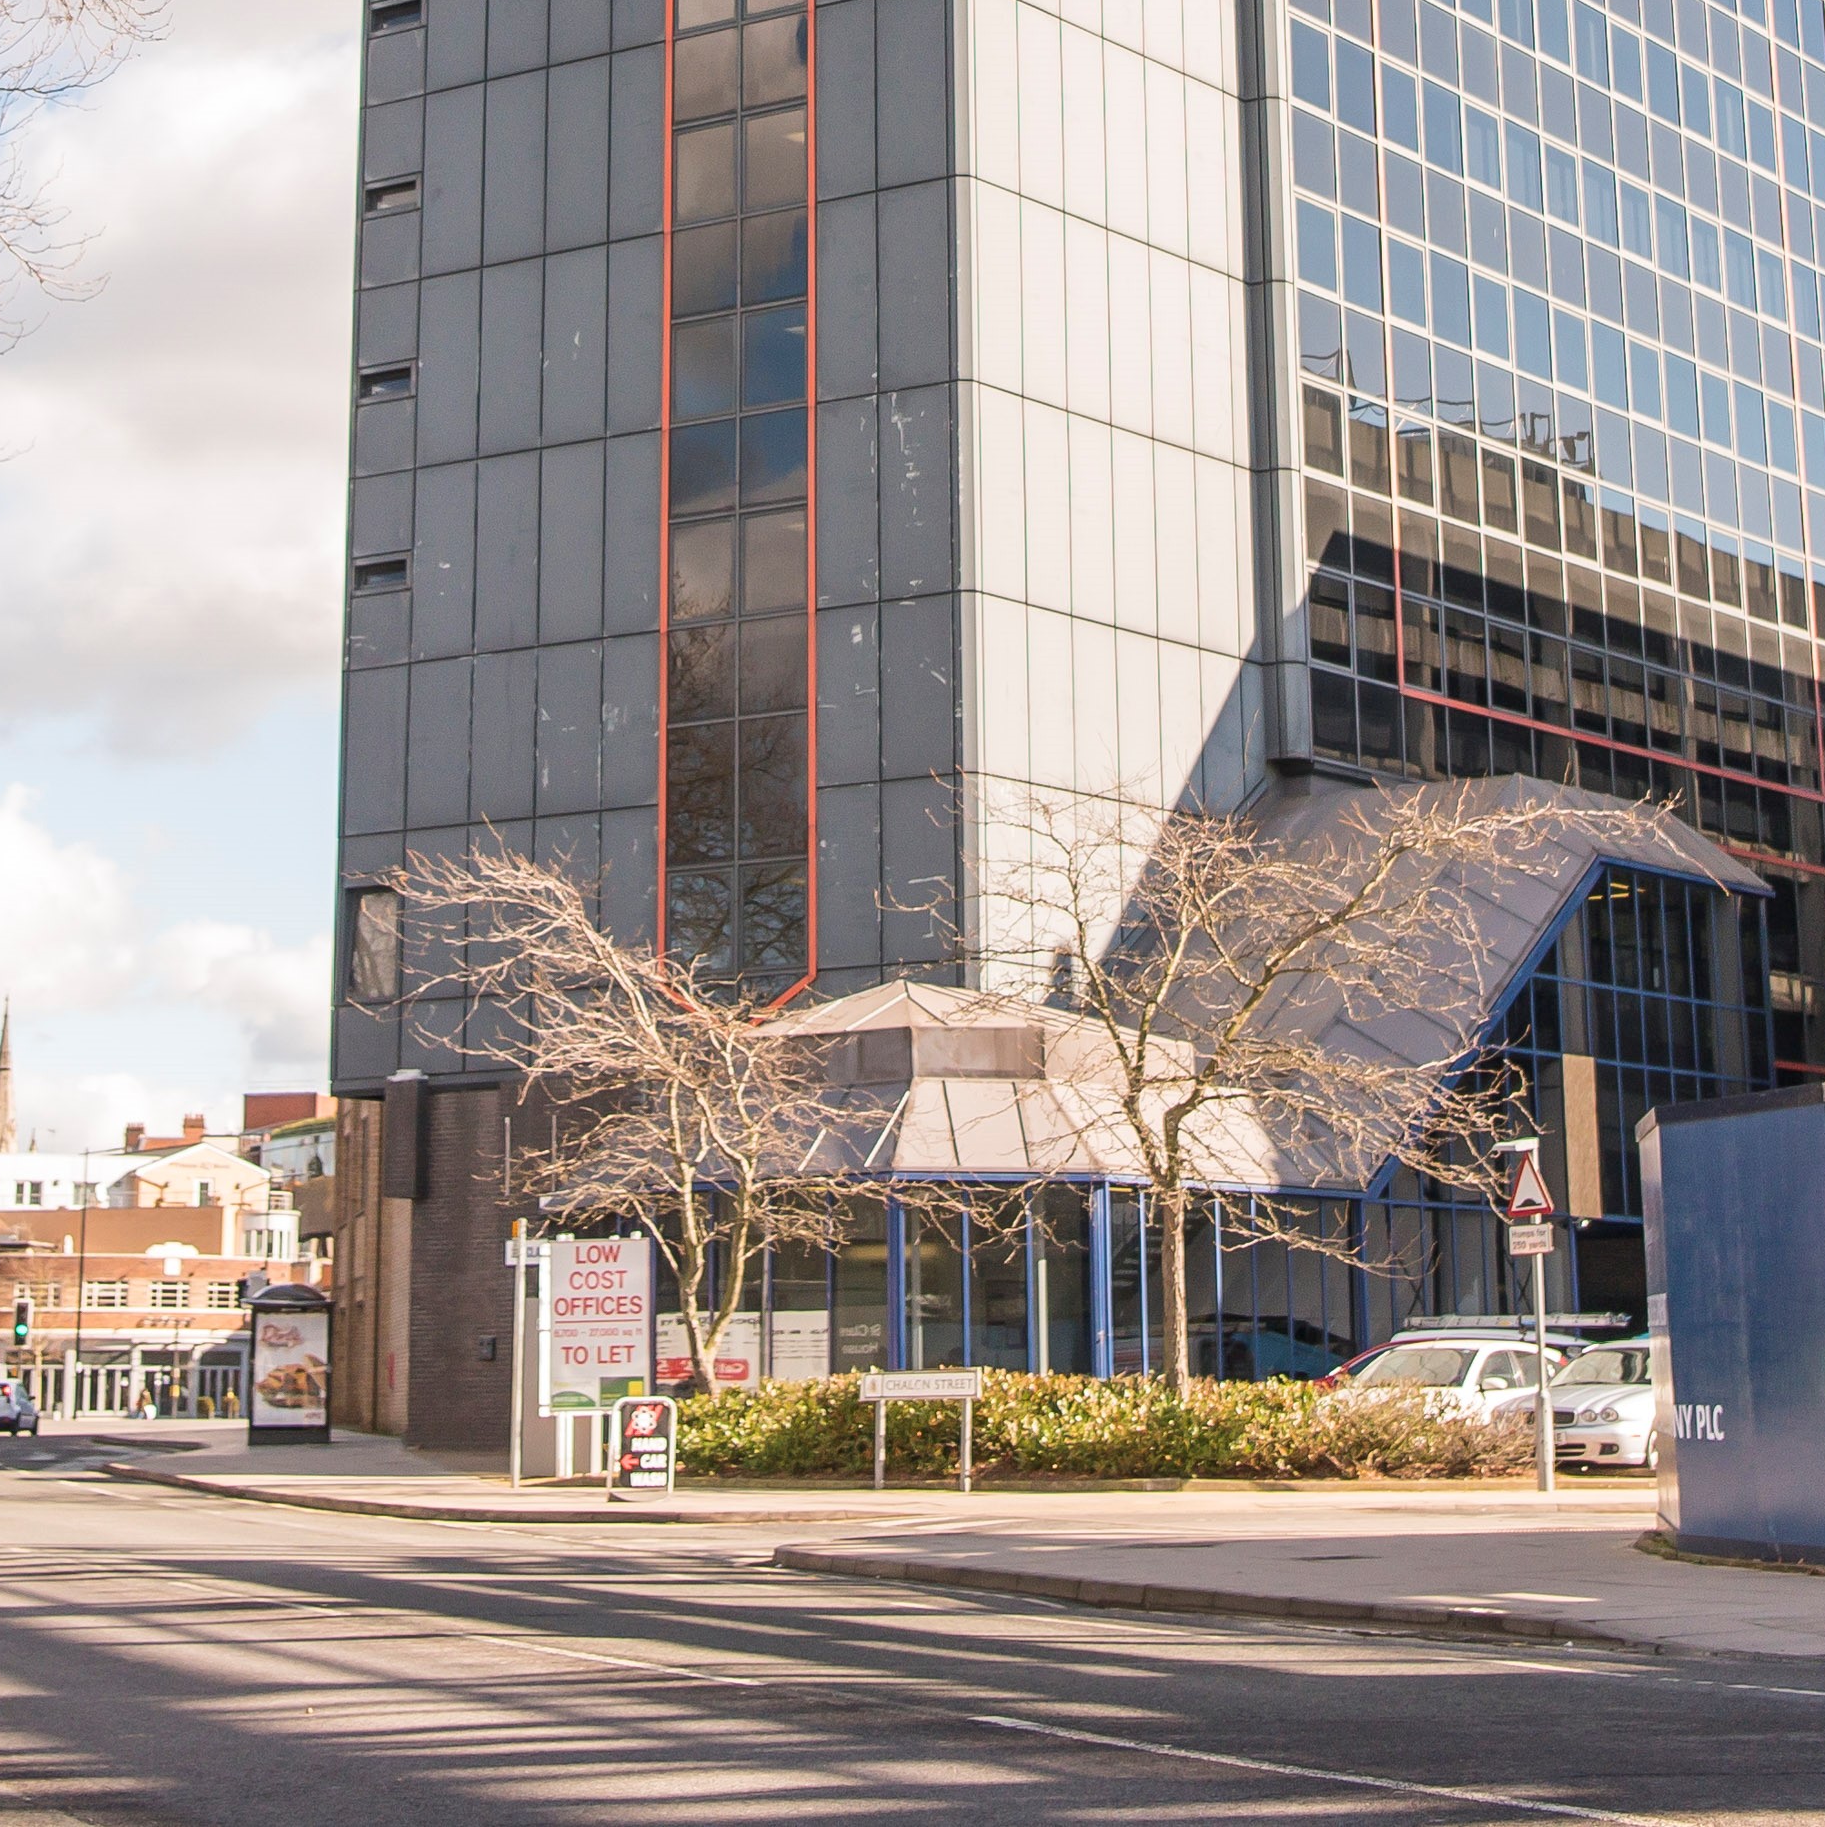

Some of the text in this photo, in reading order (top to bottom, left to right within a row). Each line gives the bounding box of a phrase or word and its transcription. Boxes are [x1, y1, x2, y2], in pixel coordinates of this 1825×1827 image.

[575, 1245, 620, 1264] LOW
[569, 1270, 627, 1290] COST
[554, 1296, 643, 1316] OFFICES
[562, 1345, 635, 1365] TO LET
[935, 1378, 973, 1390] STREET
[1696, 1404, 1725, 1441] PLC
[640, 1453, 668, 1469] CAR
[630, 1471, 668, 1487] WASH
